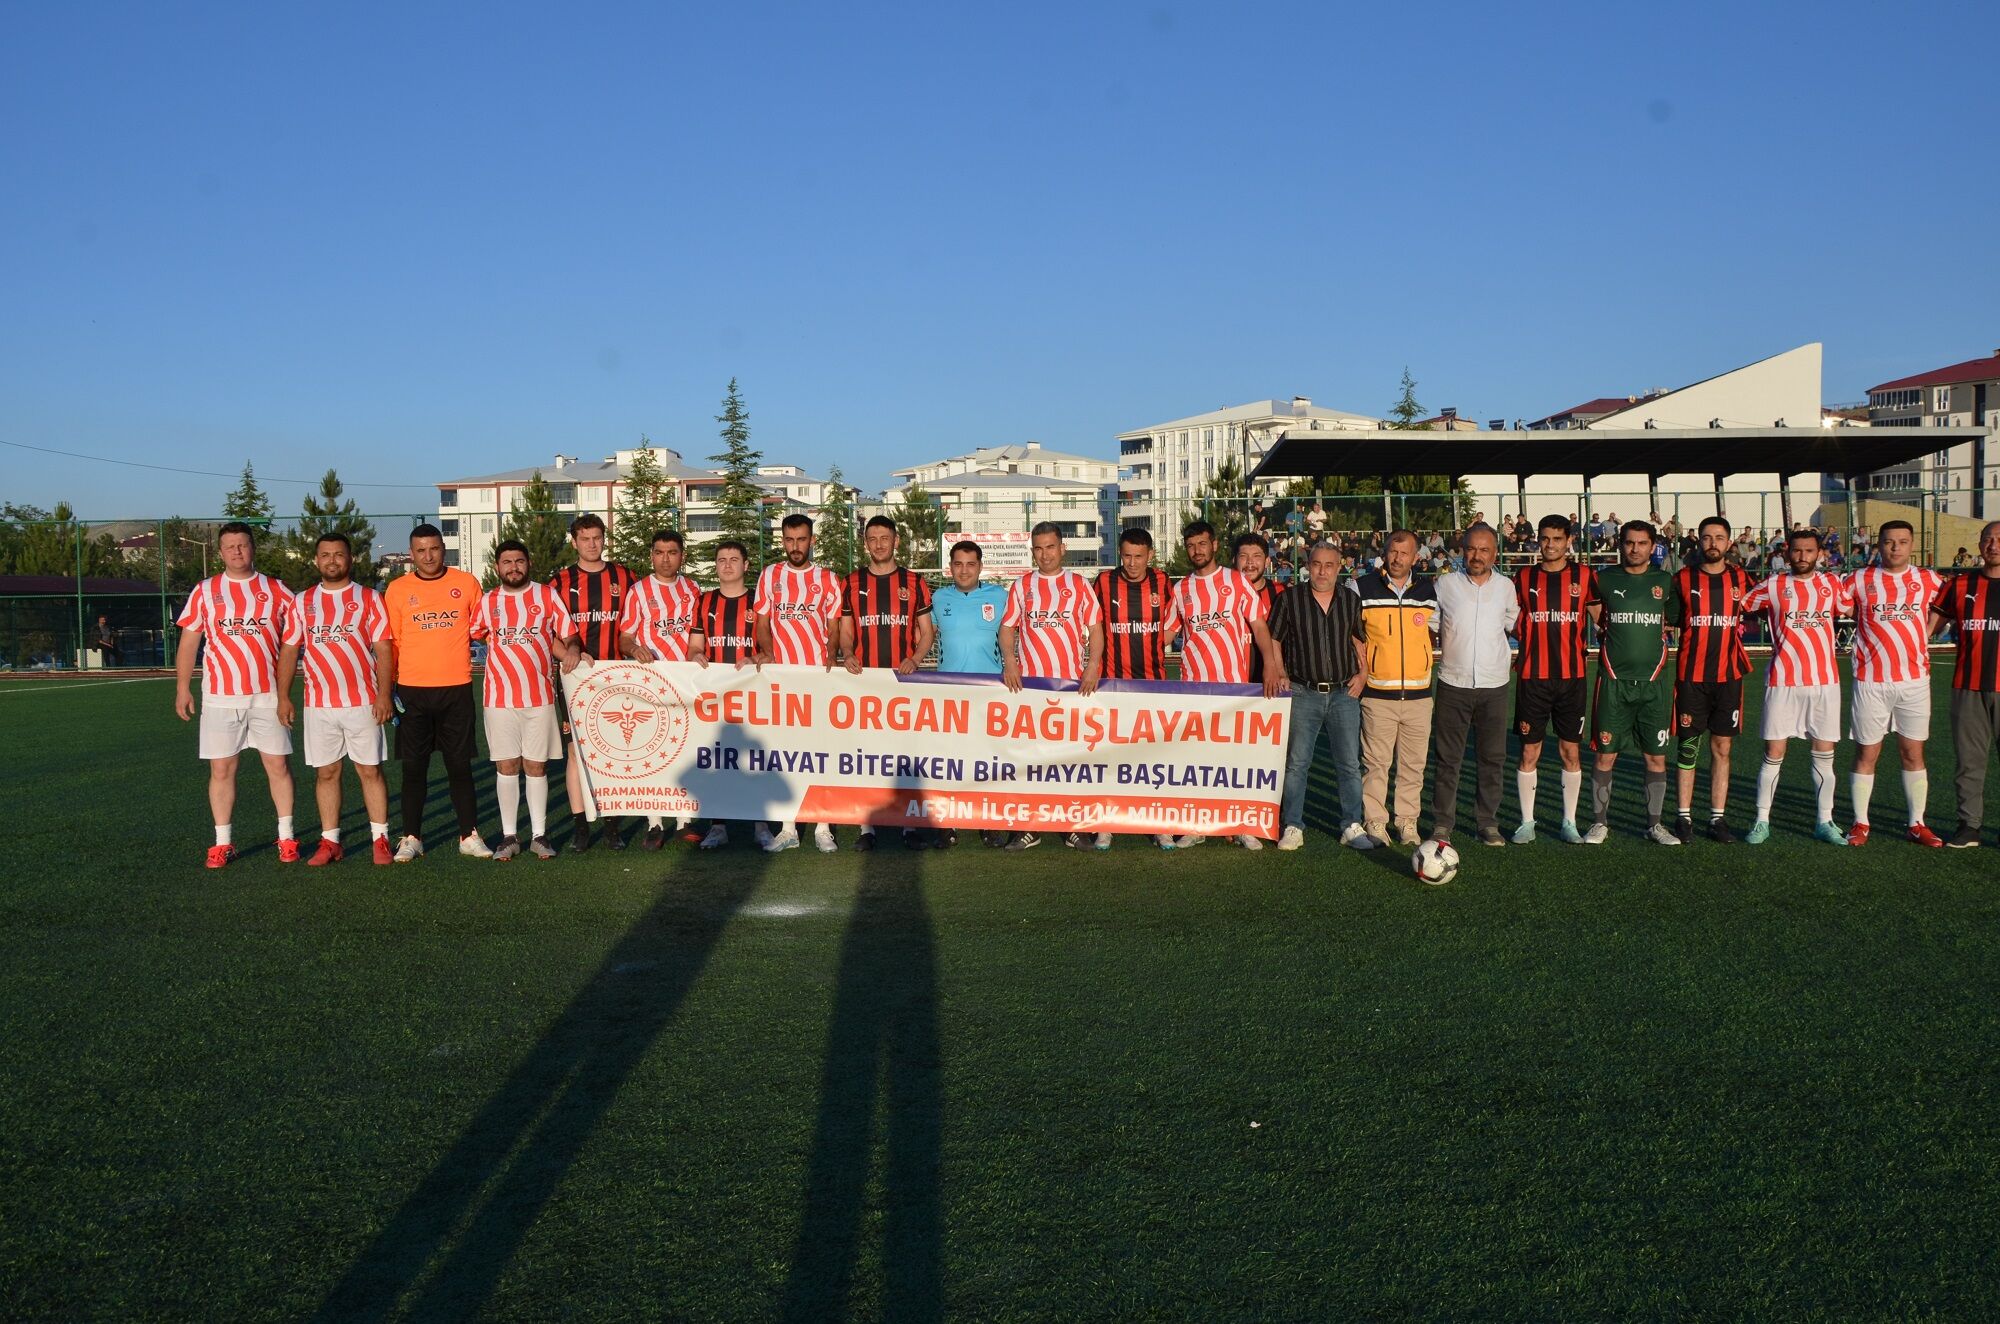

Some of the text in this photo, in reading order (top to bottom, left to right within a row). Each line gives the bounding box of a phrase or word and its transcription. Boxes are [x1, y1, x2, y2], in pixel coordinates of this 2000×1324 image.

[593, 609, 619, 624] İNŞAAT
[859, 612, 909, 627] MERT İNŞAAT
[1530, 609, 1579, 625] MERT İNŞAAT
[1611, 611, 1661, 626] MERT İNŞAAT
[1690, 616, 1712, 626] MERT
[1962, 617, 2000, 631] MERT İN
[1110, 620, 1160, 635] MERT İNŞAAT
[1196, 622, 1225, 632] BETON
[694, 684, 1282, 751] GELİN ORGAN BAĞIŞLAYALIM
[1579, 716, 1585, 734] 7
[1732, 710, 1739, 728] 9
[696, 742, 1277, 791] BİR HAYAT BİTERKEN BİR HAYAT BAŞLATALIM
[626, 799, 699, 812] MÜDÜRLÜĞÜ
[905, 797, 1274, 829] AFŞİN İLÇE SAĞLIK MÜDÜRLÜĞÜ
